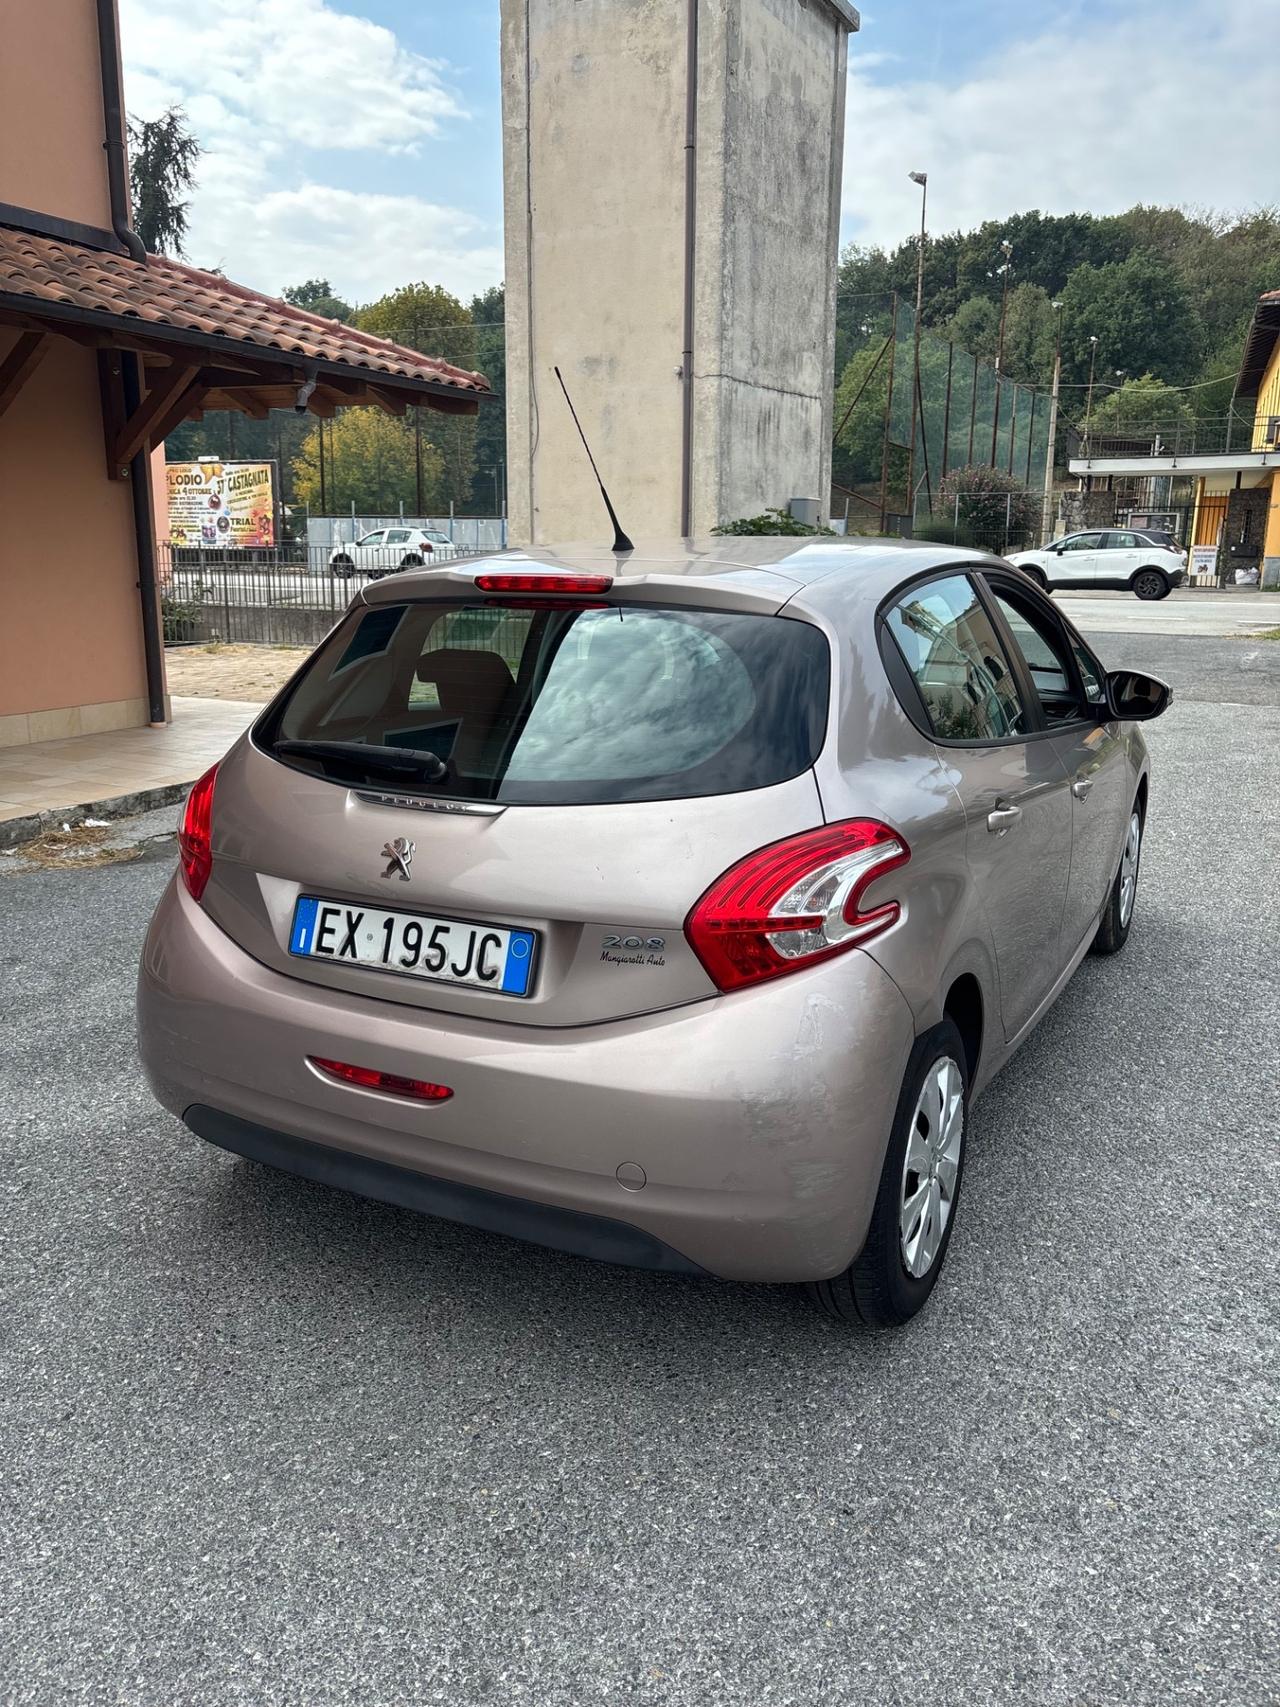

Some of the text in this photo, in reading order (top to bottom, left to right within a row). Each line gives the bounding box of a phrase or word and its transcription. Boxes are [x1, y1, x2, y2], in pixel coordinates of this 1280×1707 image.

[228, 469, 269, 492] CASTAGNATA
[182, 487, 188, 496] 4
[230, 517, 256, 526] TRIAL
[316, 907, 502, 981] EX 195JC
[601, 934, 666, 952] 208
[647, 954, 666, 967] Auto
